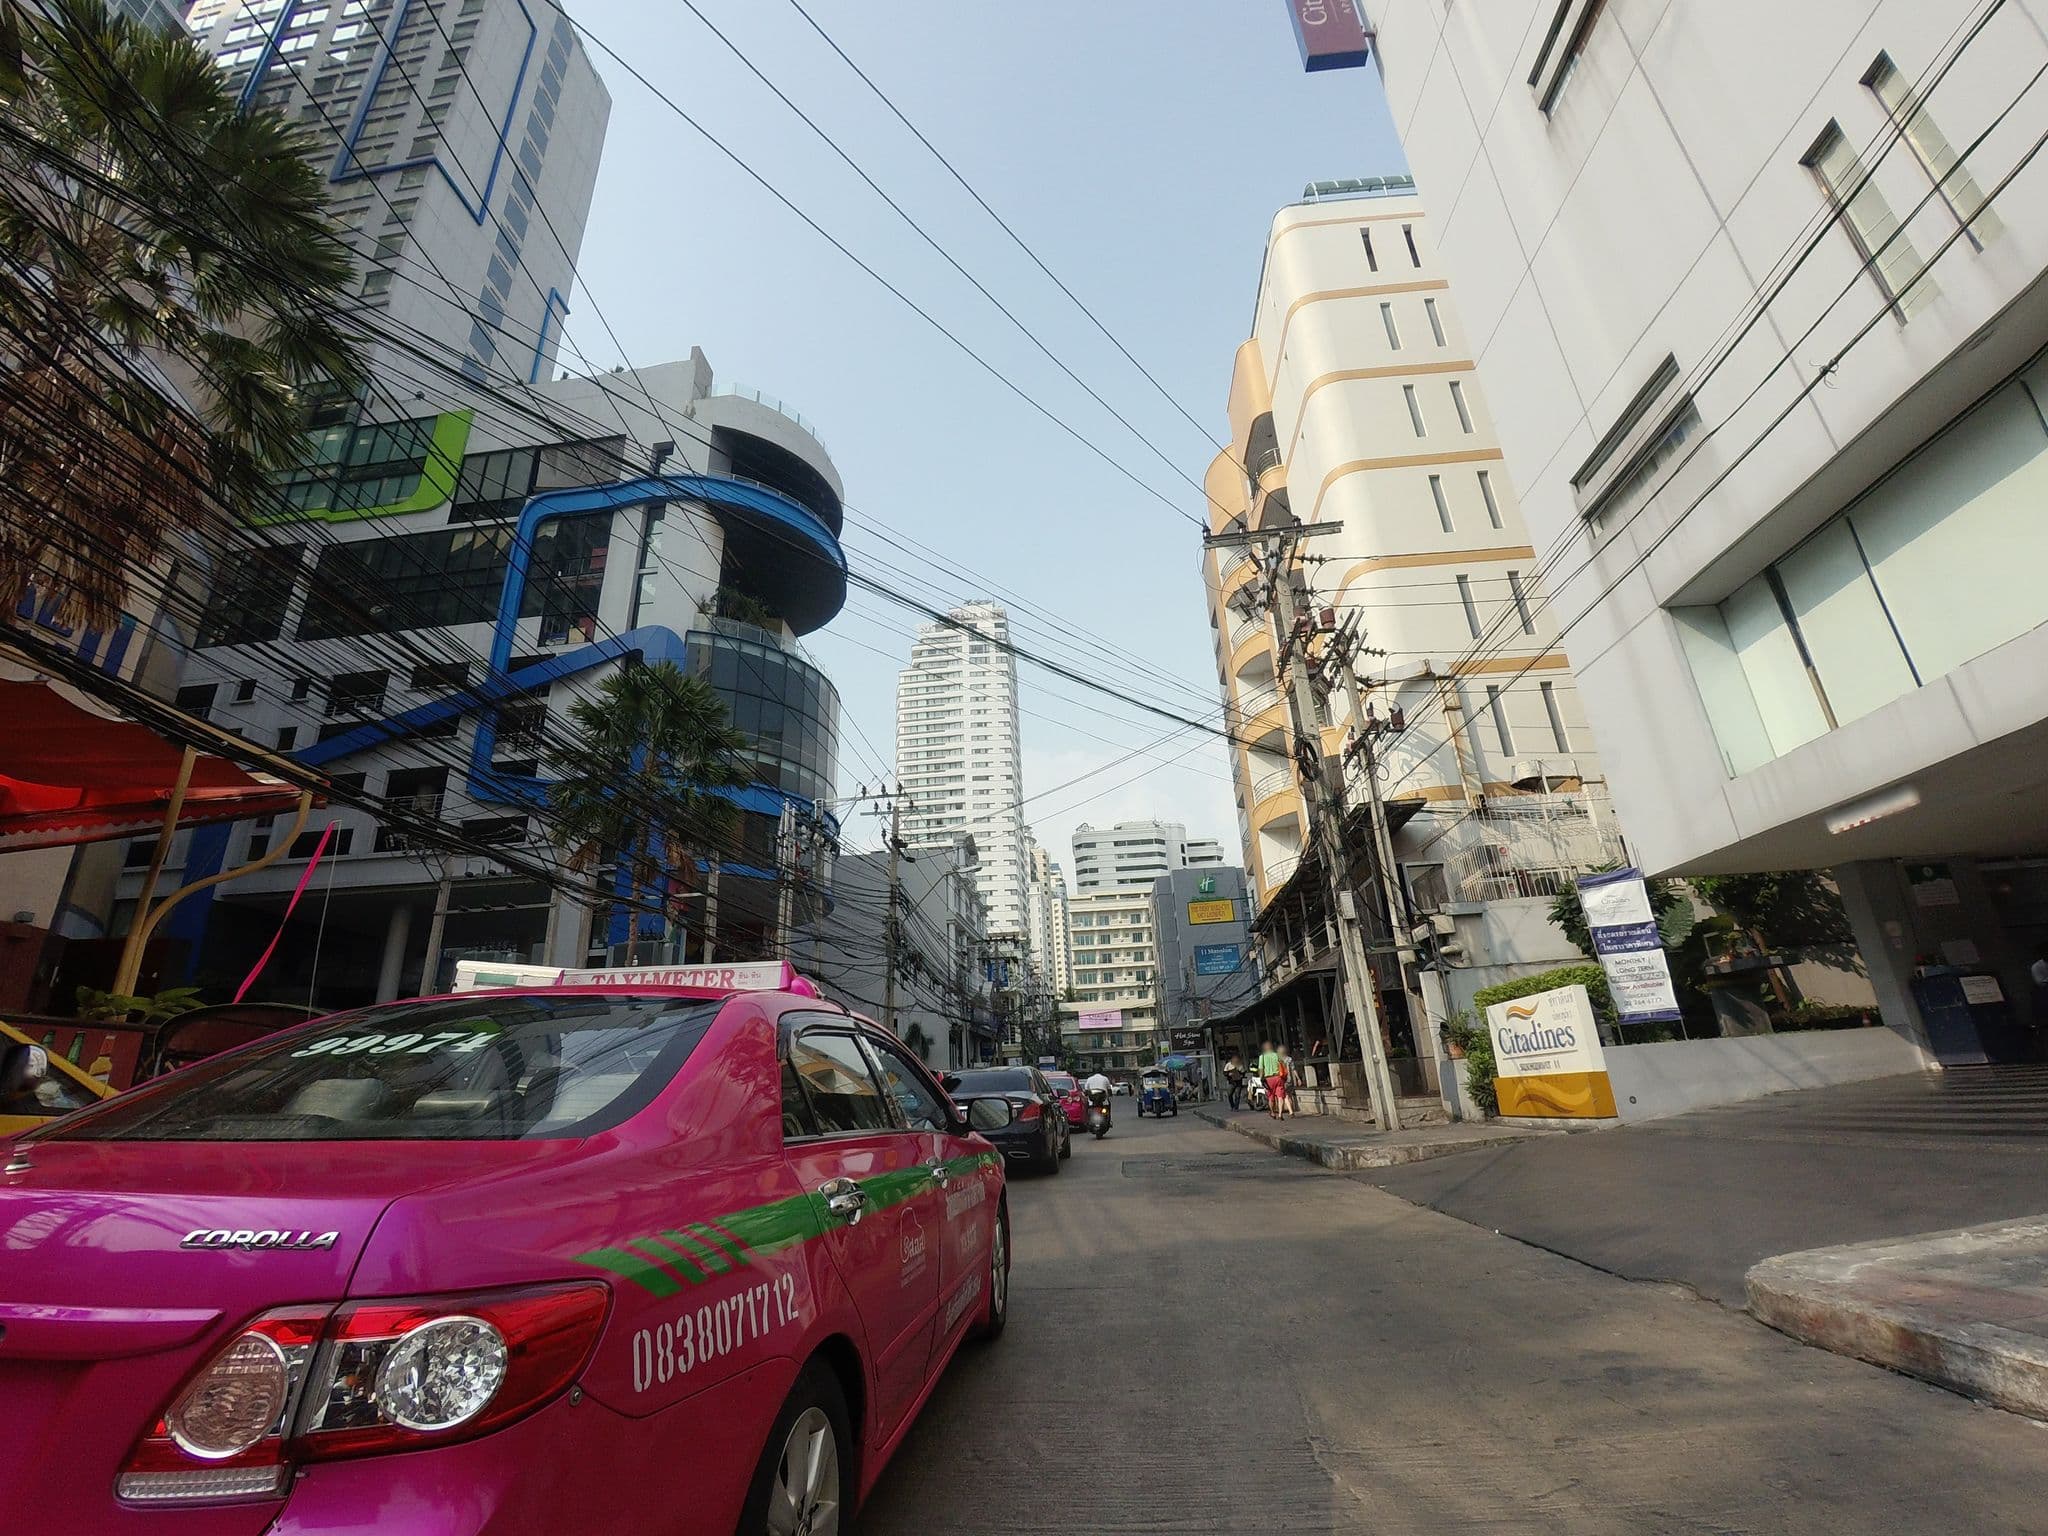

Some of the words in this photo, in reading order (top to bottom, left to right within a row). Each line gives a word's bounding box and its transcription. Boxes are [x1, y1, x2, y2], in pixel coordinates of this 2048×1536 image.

[1615, 957, 1646, 966] MONTHLY
[1616, 966, 1636, 975] LONG
[1638, 965, 1655, 973] TERM
[1174, 1031, 1186, 1040] Hot
[1182, 1039, 1195, 1047] Spa
[1498, 1020, 1576, 1055] Citadines
[291, 1032, 500, 1057] 99974
[179, 1229, 342, 1251] COROLLA
[632, 1272, 800, 1393] 0838071712
